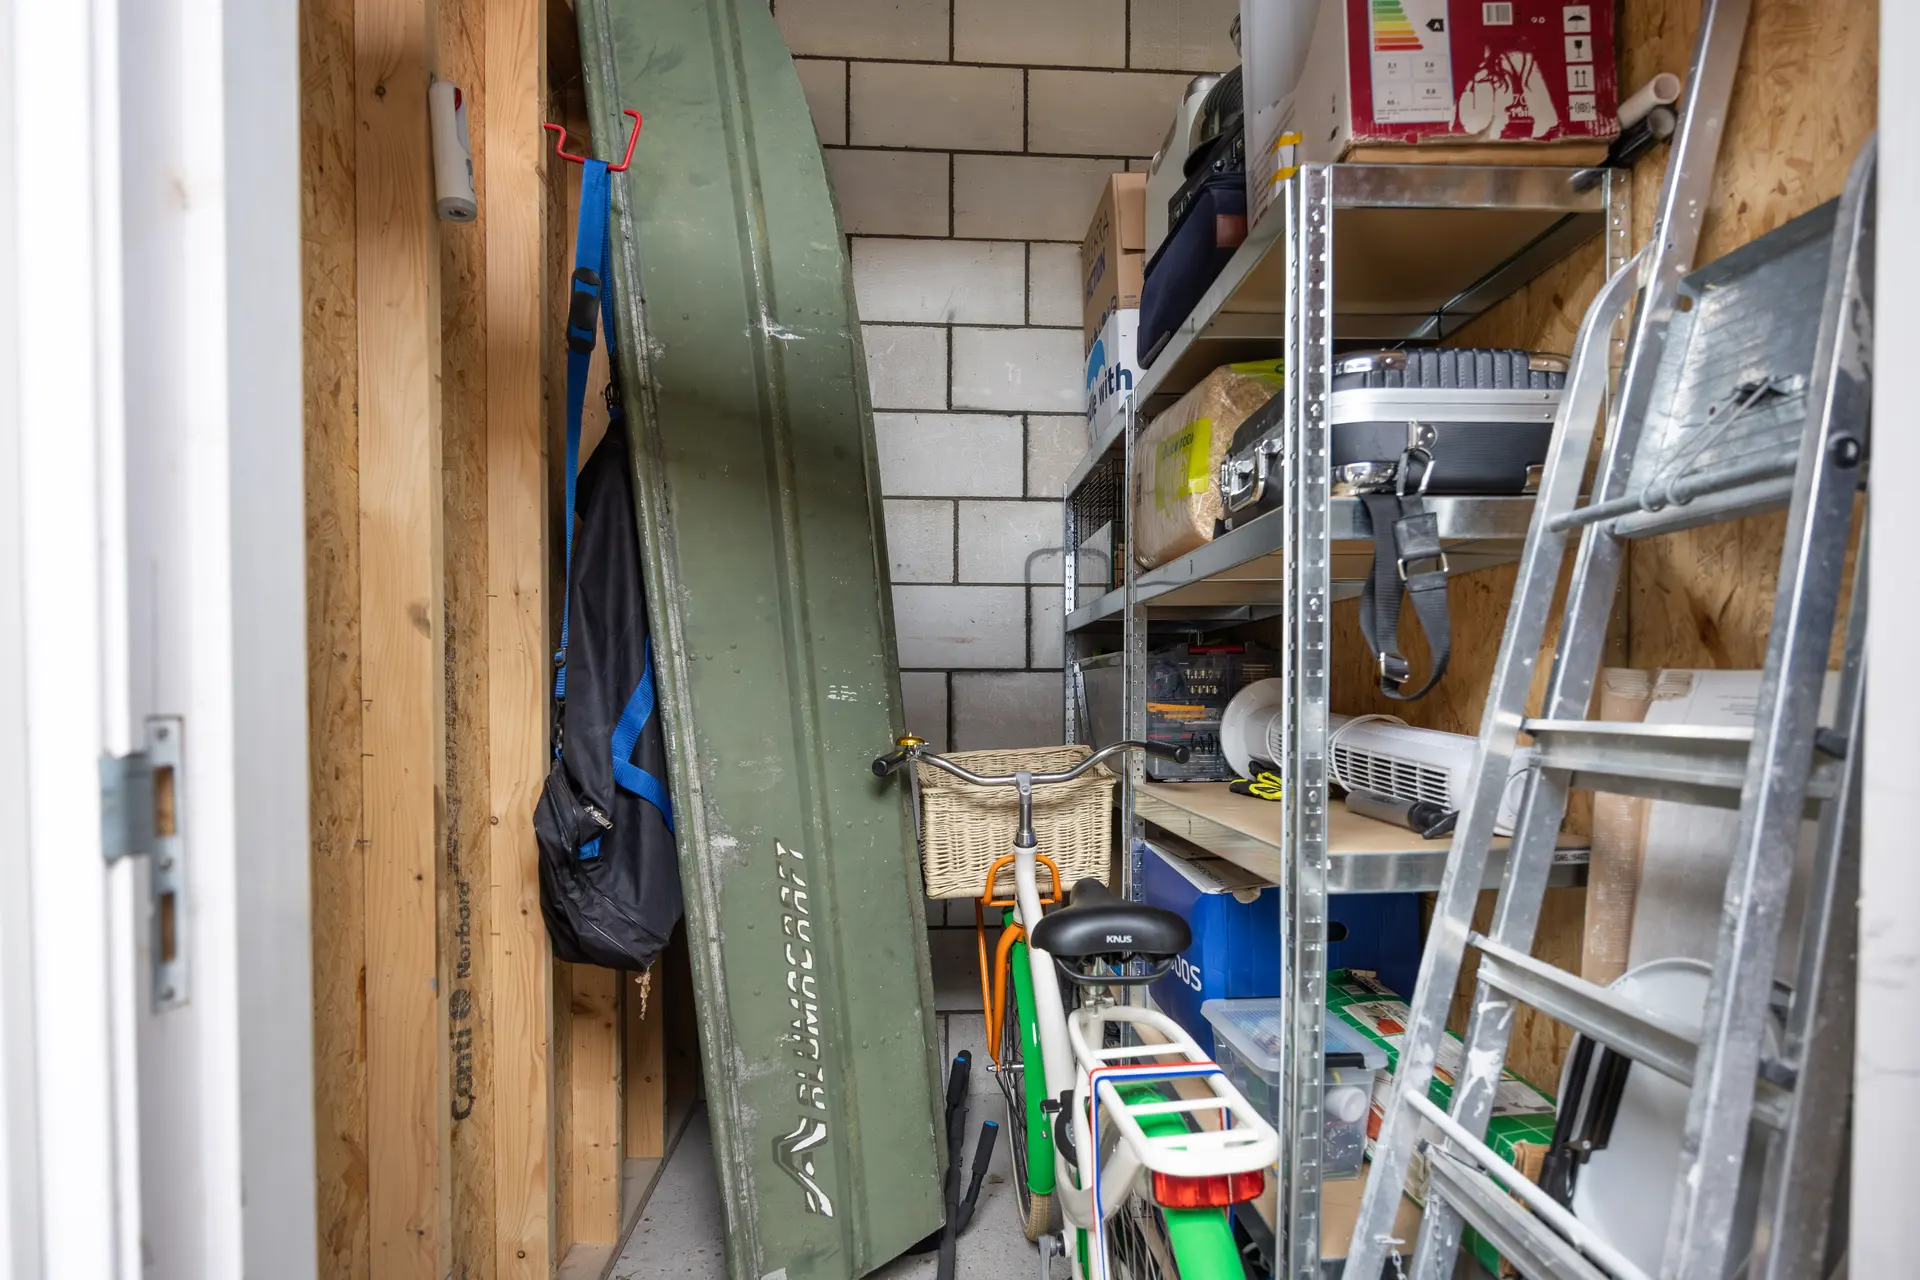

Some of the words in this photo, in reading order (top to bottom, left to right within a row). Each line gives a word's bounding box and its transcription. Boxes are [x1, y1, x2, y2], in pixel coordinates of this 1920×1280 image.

[1098, 361, 1133, 406] with
[1106, 935, 1132, 944] KNUS
[773, 836, 827, 1111] ALUMACRAFT
